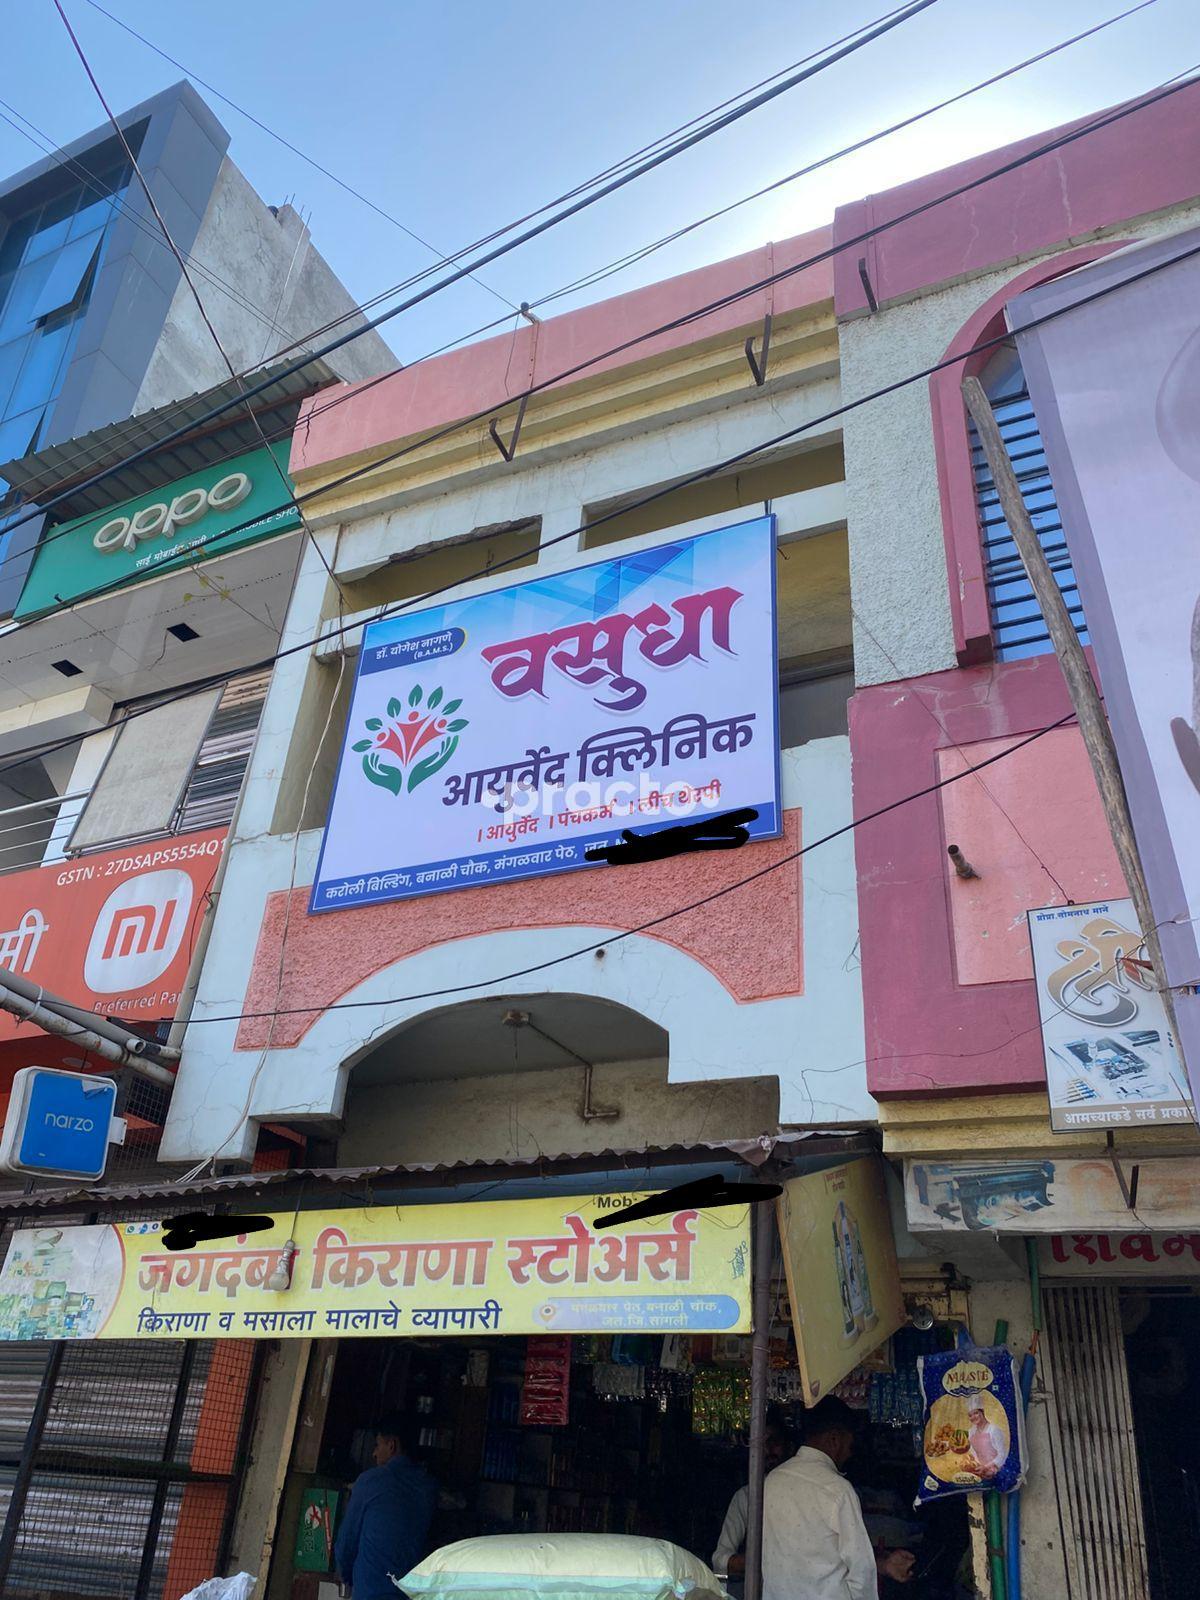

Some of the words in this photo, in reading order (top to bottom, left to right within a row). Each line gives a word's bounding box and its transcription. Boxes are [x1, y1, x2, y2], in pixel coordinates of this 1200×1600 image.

[93, 472, 252, 553] oppo
[376, 646, 388, 660] डॉ.
[390, 640, 420, 655] योगेश
[421, 631, 452, 647] नागणे
[414, 643, 453, 660] (B.A.M.S.)
[480, 586, 744, 711] वसुधा
[442, 746, 570, 813] आयुर्वेद
[577, 713, 756, 782] क्लिनिक
[486, 816, 540, 842] आयुर्वेद
[558, 799, 615, 828] पंचकर्म
[56, 866, 95, 886] GSTN
[325, 879, 364, 900] करोली
[367, 873, 413, 893] बिल्डिंग,
[416, 864, 457, 884] बनाळी
[461, 859, 491, 876] चौक,
[494, 849, 553, 870] मंगळवार
[554, 844, 578, 860] पेठ,
[93, 994, 156, 1013] Preferred
[45, 1113, 94, 1132] narzo
[1064, 1106, 1131, 1124] आमच्याकडे
[1135, 1105, 1156, 1120] सर्व
[311, 1227, 493, 1289] किराणा
[507, 1210, 699, 1284] स्टोअर्स
[137, 1307, 211, 1333] किराणा
[218, 1312, 235, 1331] व
[244, 1311, 316, 1331] मसाला
[326, 1300, 401, 1330] मालाचे
[412, 1299, 502, 1329] व्यापारी
